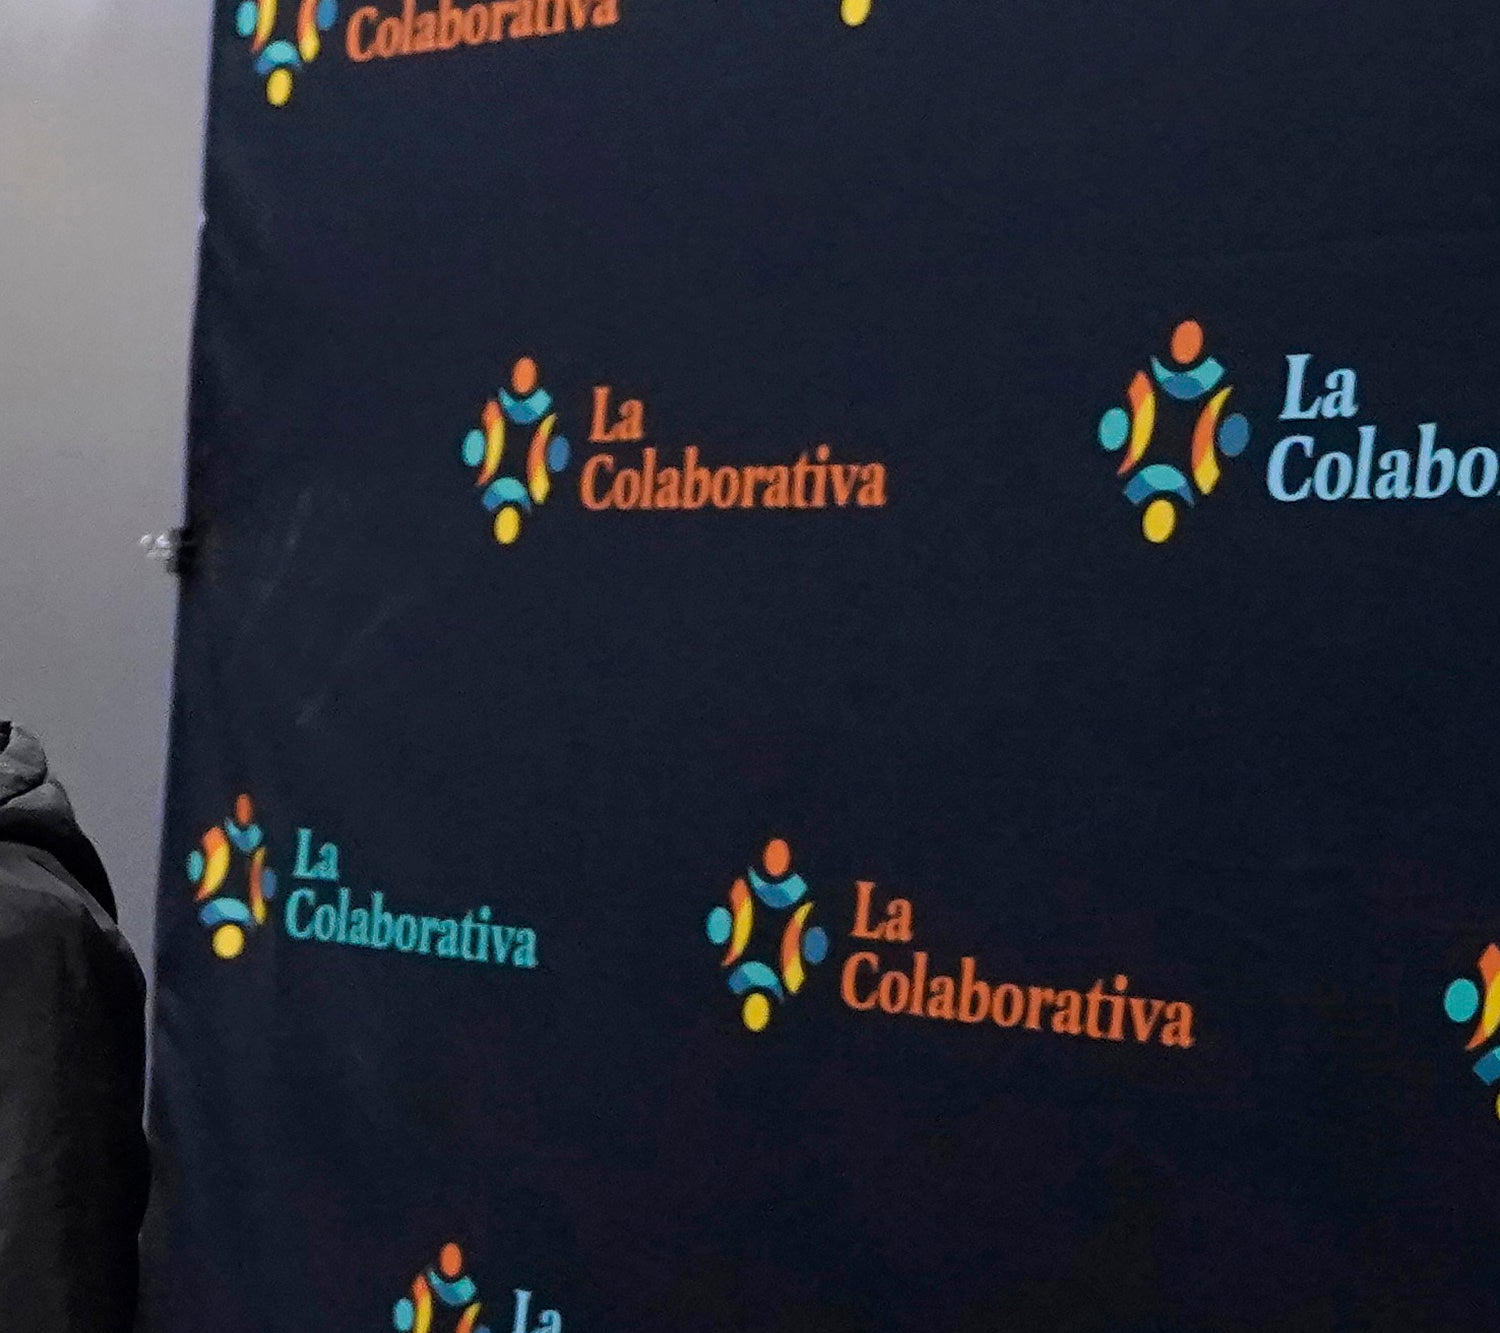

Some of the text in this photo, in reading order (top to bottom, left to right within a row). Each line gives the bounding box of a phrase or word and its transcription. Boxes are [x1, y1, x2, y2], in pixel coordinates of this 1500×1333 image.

[345, 0, 619, 62] Colaborativa
[589, 386, 644, 443] La
[1279, 353, 1358, 420] La
[580, 444, 886, 511] Colaborativa
[292, 827, 340, 881] La
[284, 887, 538, 968] Colaborativa
[851, 880, 914, 944] La
[841, 951, 1194, 1048] Colaborativa
